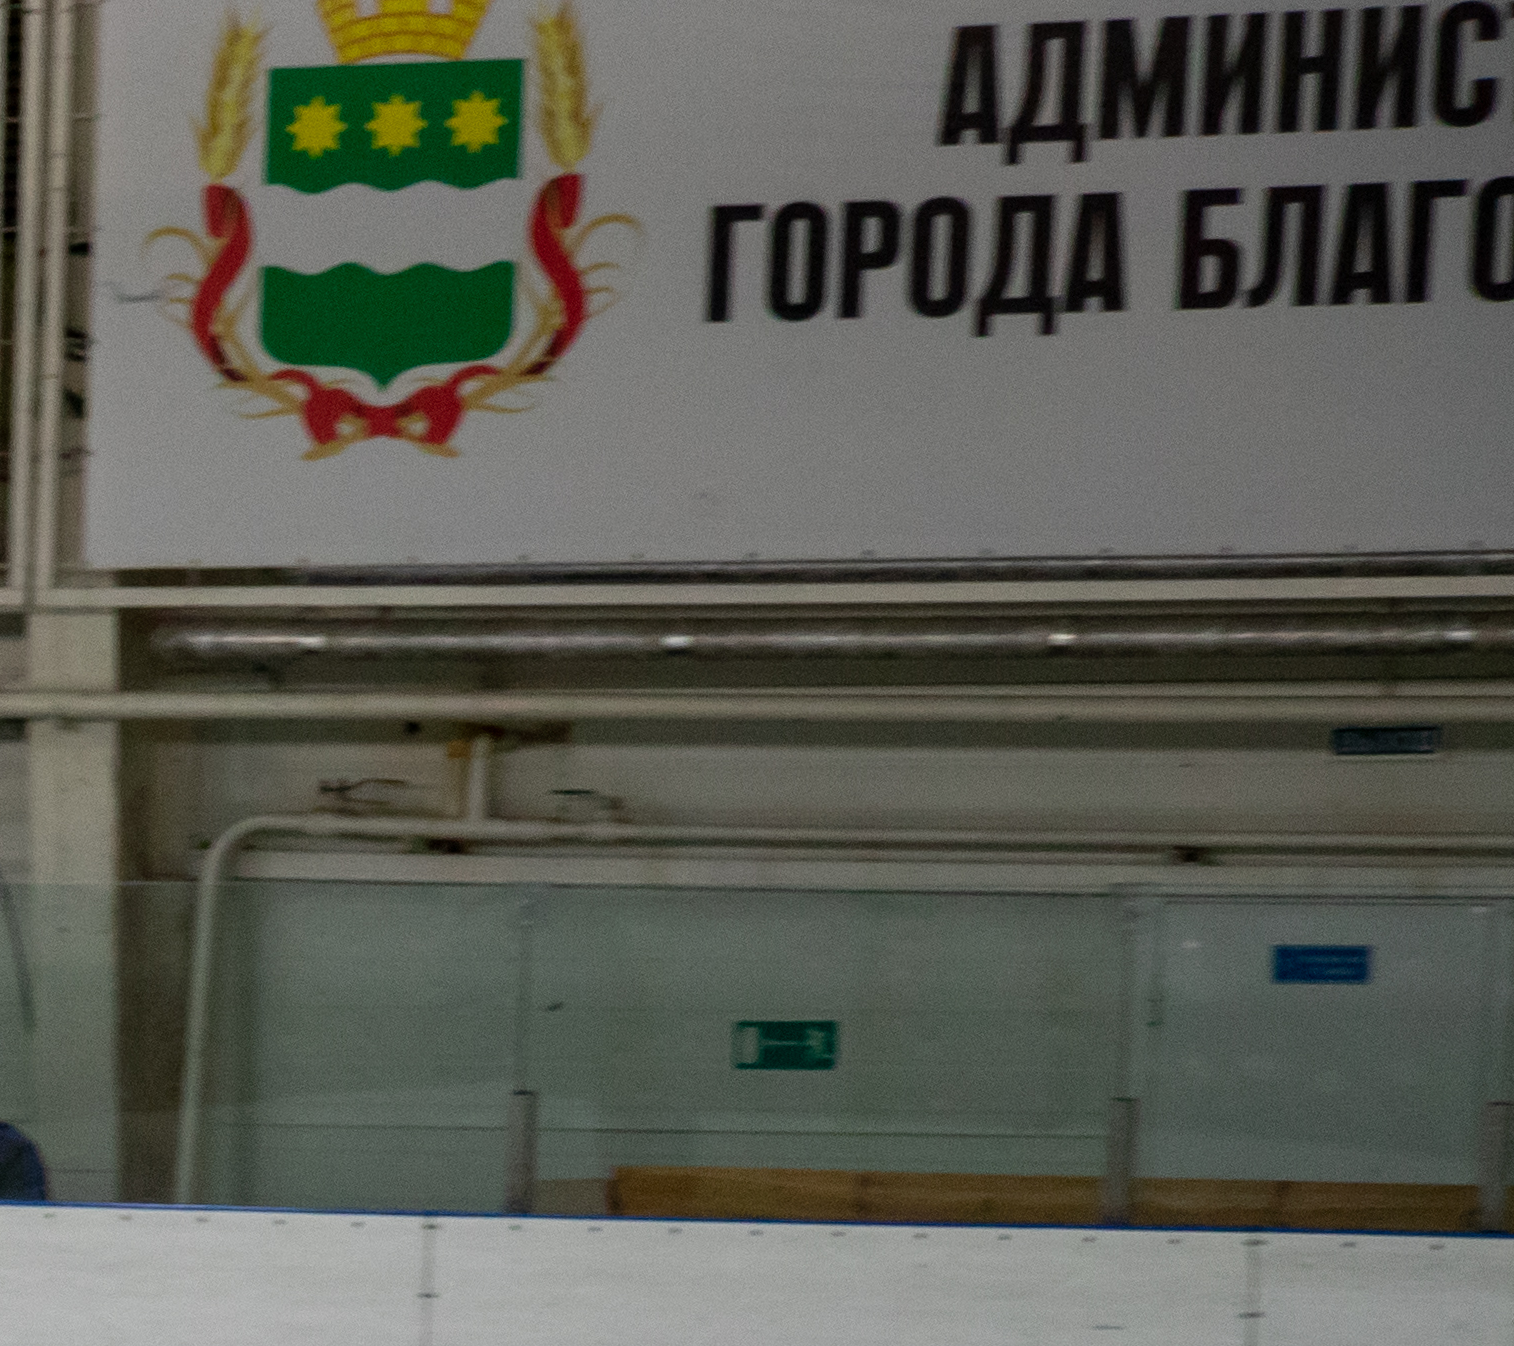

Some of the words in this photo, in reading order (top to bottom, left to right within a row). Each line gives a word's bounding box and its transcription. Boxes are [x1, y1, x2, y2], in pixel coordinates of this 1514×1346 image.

[936, 0, 1514, 166] АДМИНИС
[704, 191, 1130, 338] ГОРОДА
[1173, 176, 1514, 310] БЛАГО
